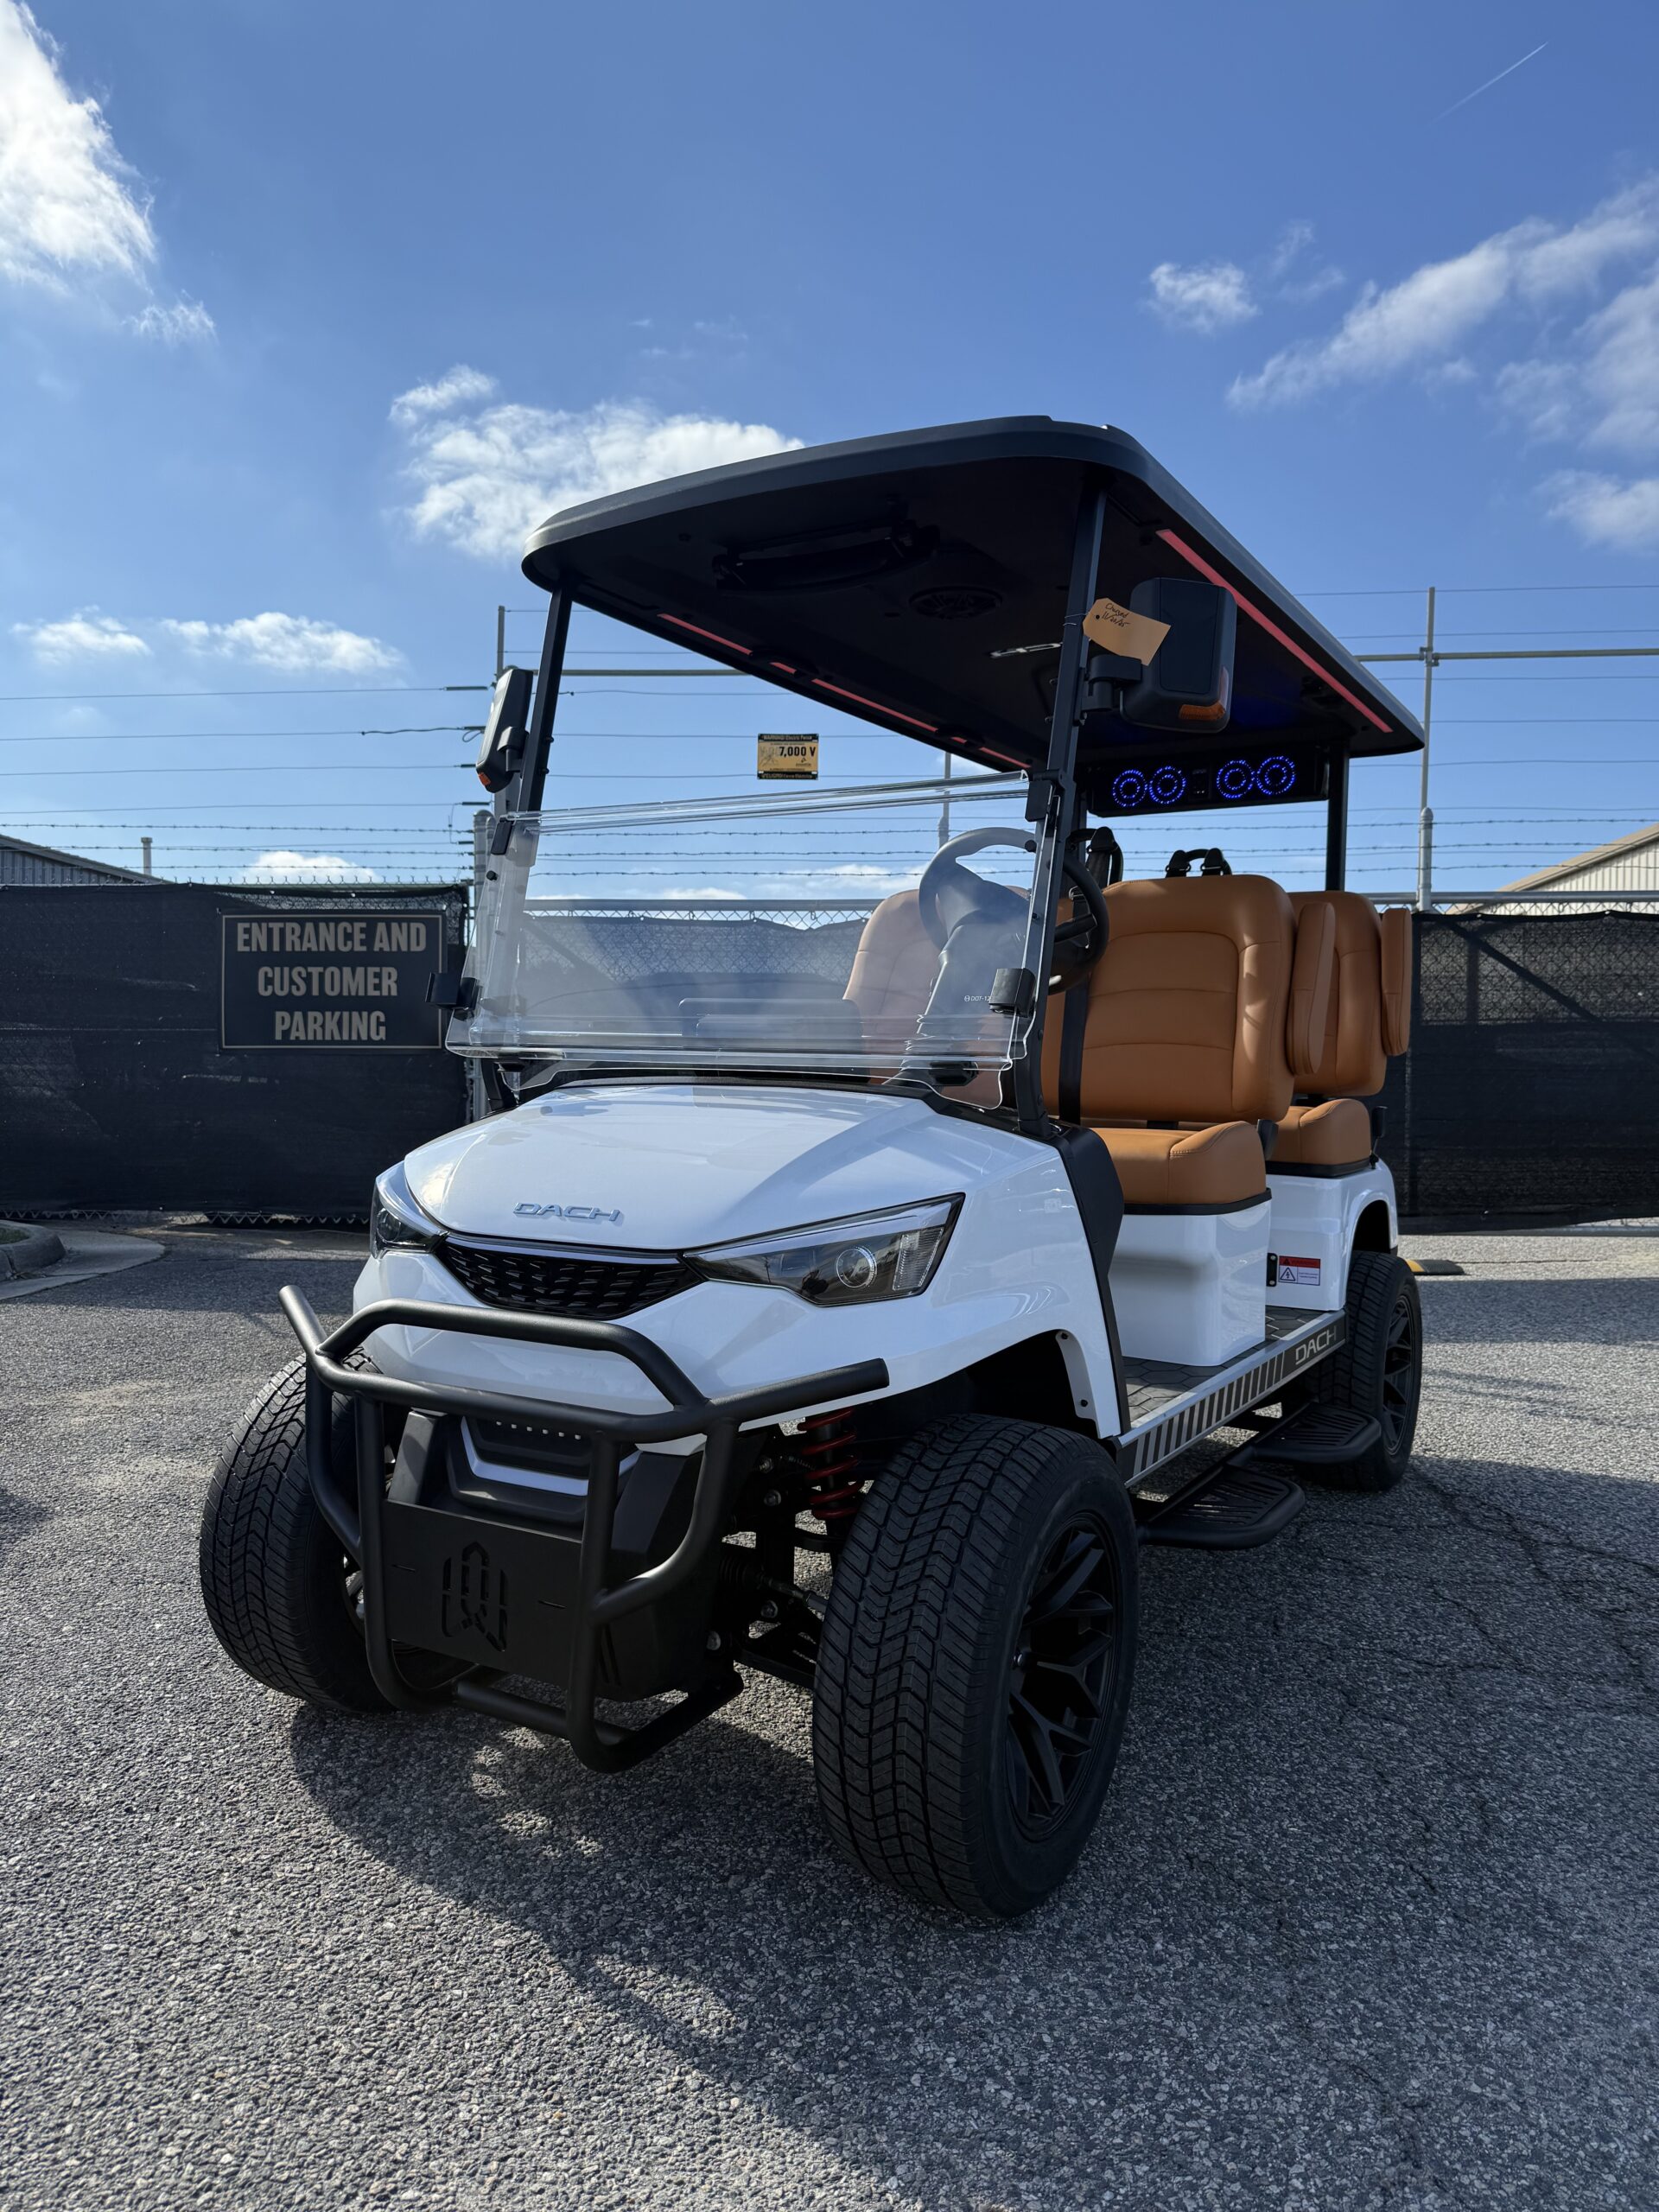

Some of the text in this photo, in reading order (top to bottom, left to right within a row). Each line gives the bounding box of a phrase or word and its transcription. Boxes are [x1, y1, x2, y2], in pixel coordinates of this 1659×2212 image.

[779, 746, 817, 758] 7,000 V
[237, 922, 427, 952] ENTRANCE AND
[257, 966, 397, 996] CUSTOMER
[275, 1010, 386, 1041] PARKING
[512, 1202, 620, 1222] DACH
[1295, 1325, 1338, 1365] DACH
